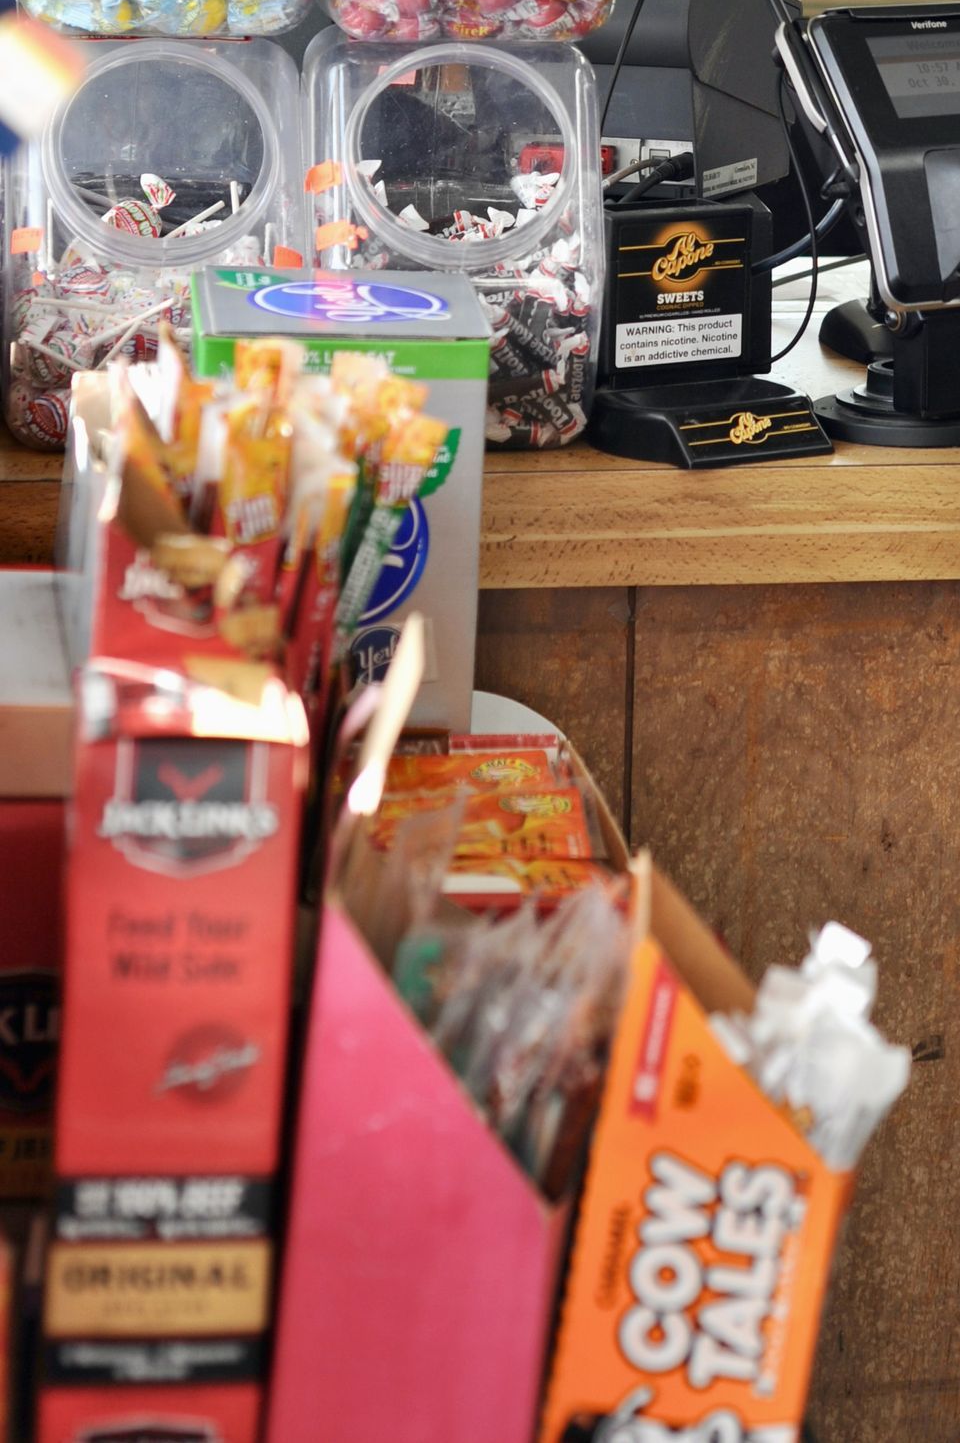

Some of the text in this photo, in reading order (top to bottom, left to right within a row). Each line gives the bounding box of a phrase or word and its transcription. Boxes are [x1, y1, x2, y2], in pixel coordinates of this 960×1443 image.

[911, 20, 947, 29] Verifone
[908, 77, 929, 88] Oct
[651, 243, 714, 281] Capone
[656, 301, 704, 311] COGNAC DIPPED
[657, 290, 704, 305] SWEETS
[626, 319, 733, 336] WARNING: This product
[620, 332, 738, 350] contains nicotine. Nicotine
[624, 345, 733, 363] is an addictive chemical.
[617, 1152, 719, 1375] COW
[61, 1263, 250, 1293] ORIGINAL
[686, 1161, 797, 1390] TALES
